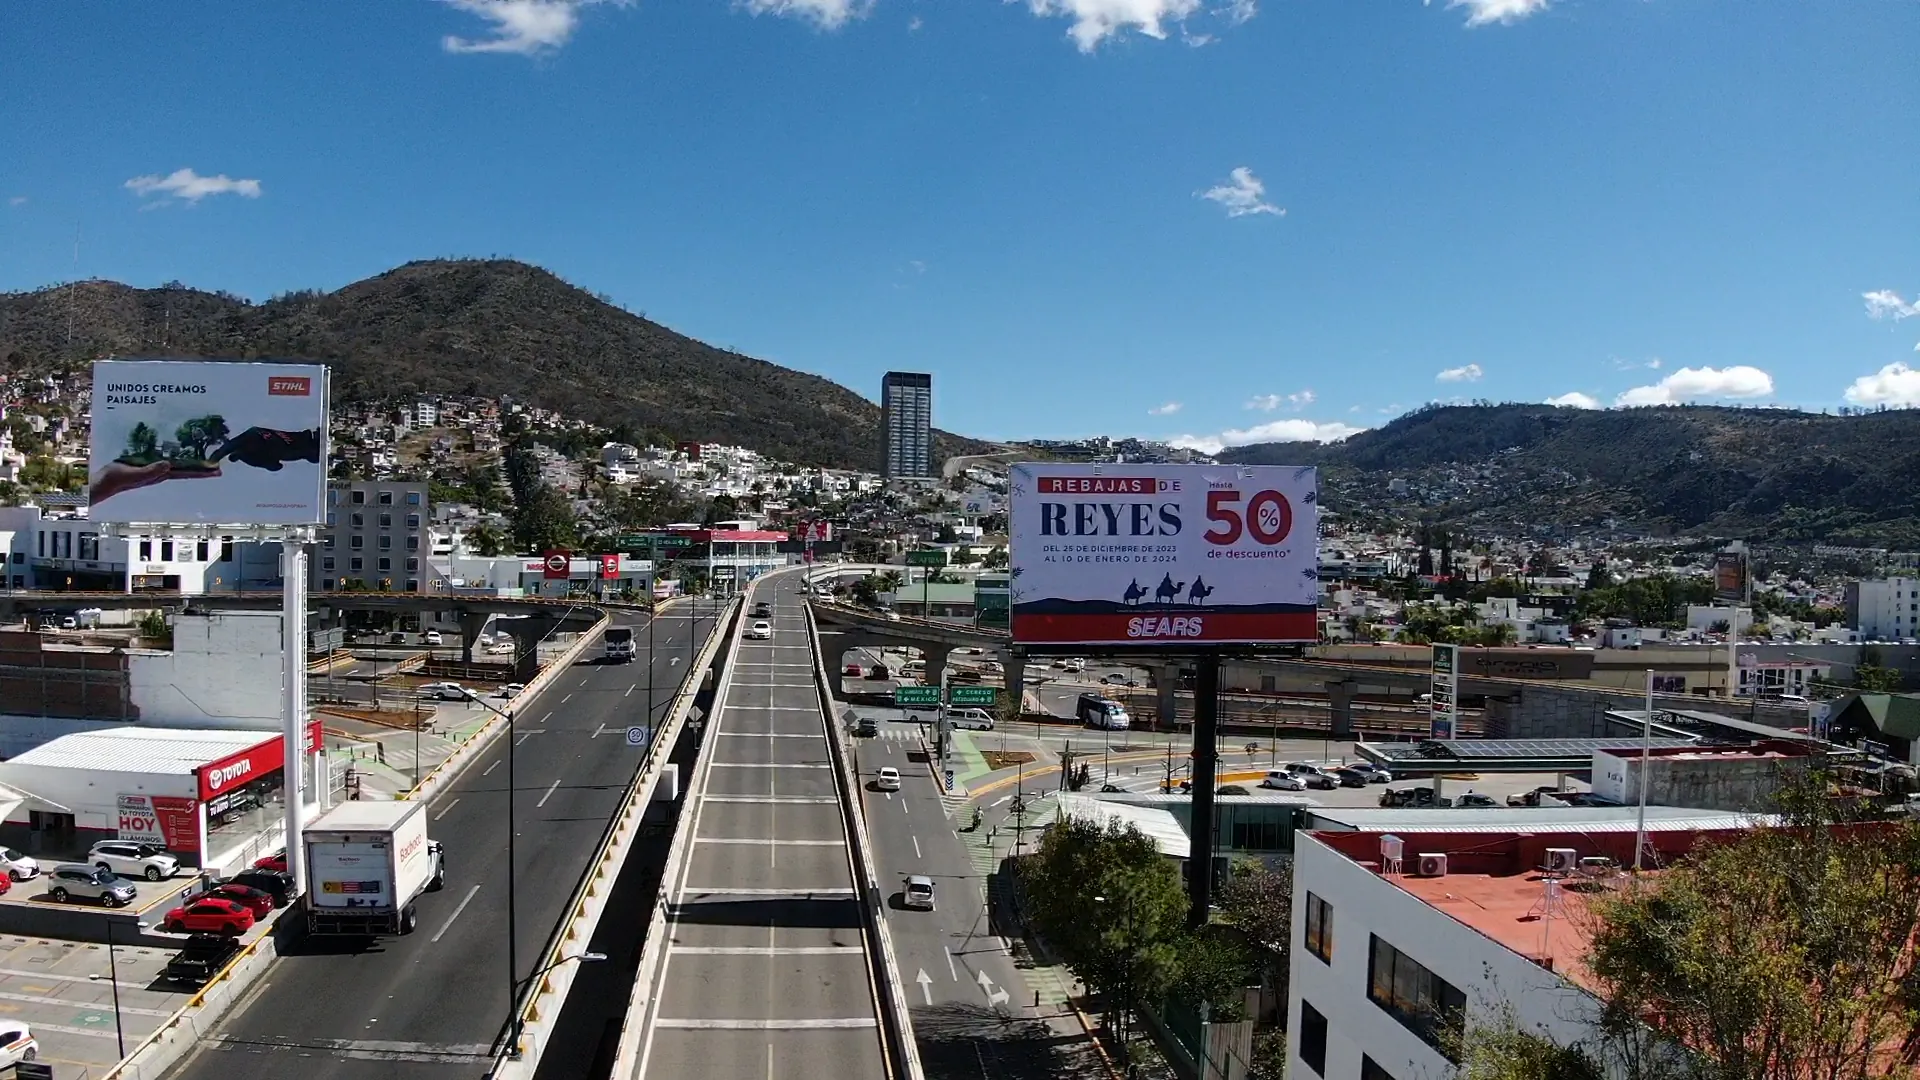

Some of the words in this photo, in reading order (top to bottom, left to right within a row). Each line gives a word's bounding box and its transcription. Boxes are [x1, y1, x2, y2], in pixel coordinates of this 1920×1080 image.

[107, 383, 149, 393] UNIDOS
[152, 384, 207, 394] CREAMOS
[272, 382, 306, 391] STIHL
[107, 395, 157, 404] PAISAJES
[1052, 479, 1142, 492] REBAJAS
[1158, 481, 1182, 491] DE
[1039, 502, 1183, 536] REYES
[1043, 545, 1060, 553] DEL
[1062, 545, 1074, 553] 25
[1076, 545, 1088, 553] DE
[1091, 545, 1139, 553] DICIEMBRE
[1141, 545, 1153, 553] DE
[1207, 549, 1222, 559] de
[1127, 617, 1203, 637] SEARS
[222, 758, 252, 783] TOYOTA
[119, 816, 156, 832] HOY
[400, 833, 422, 863] Bachoco
